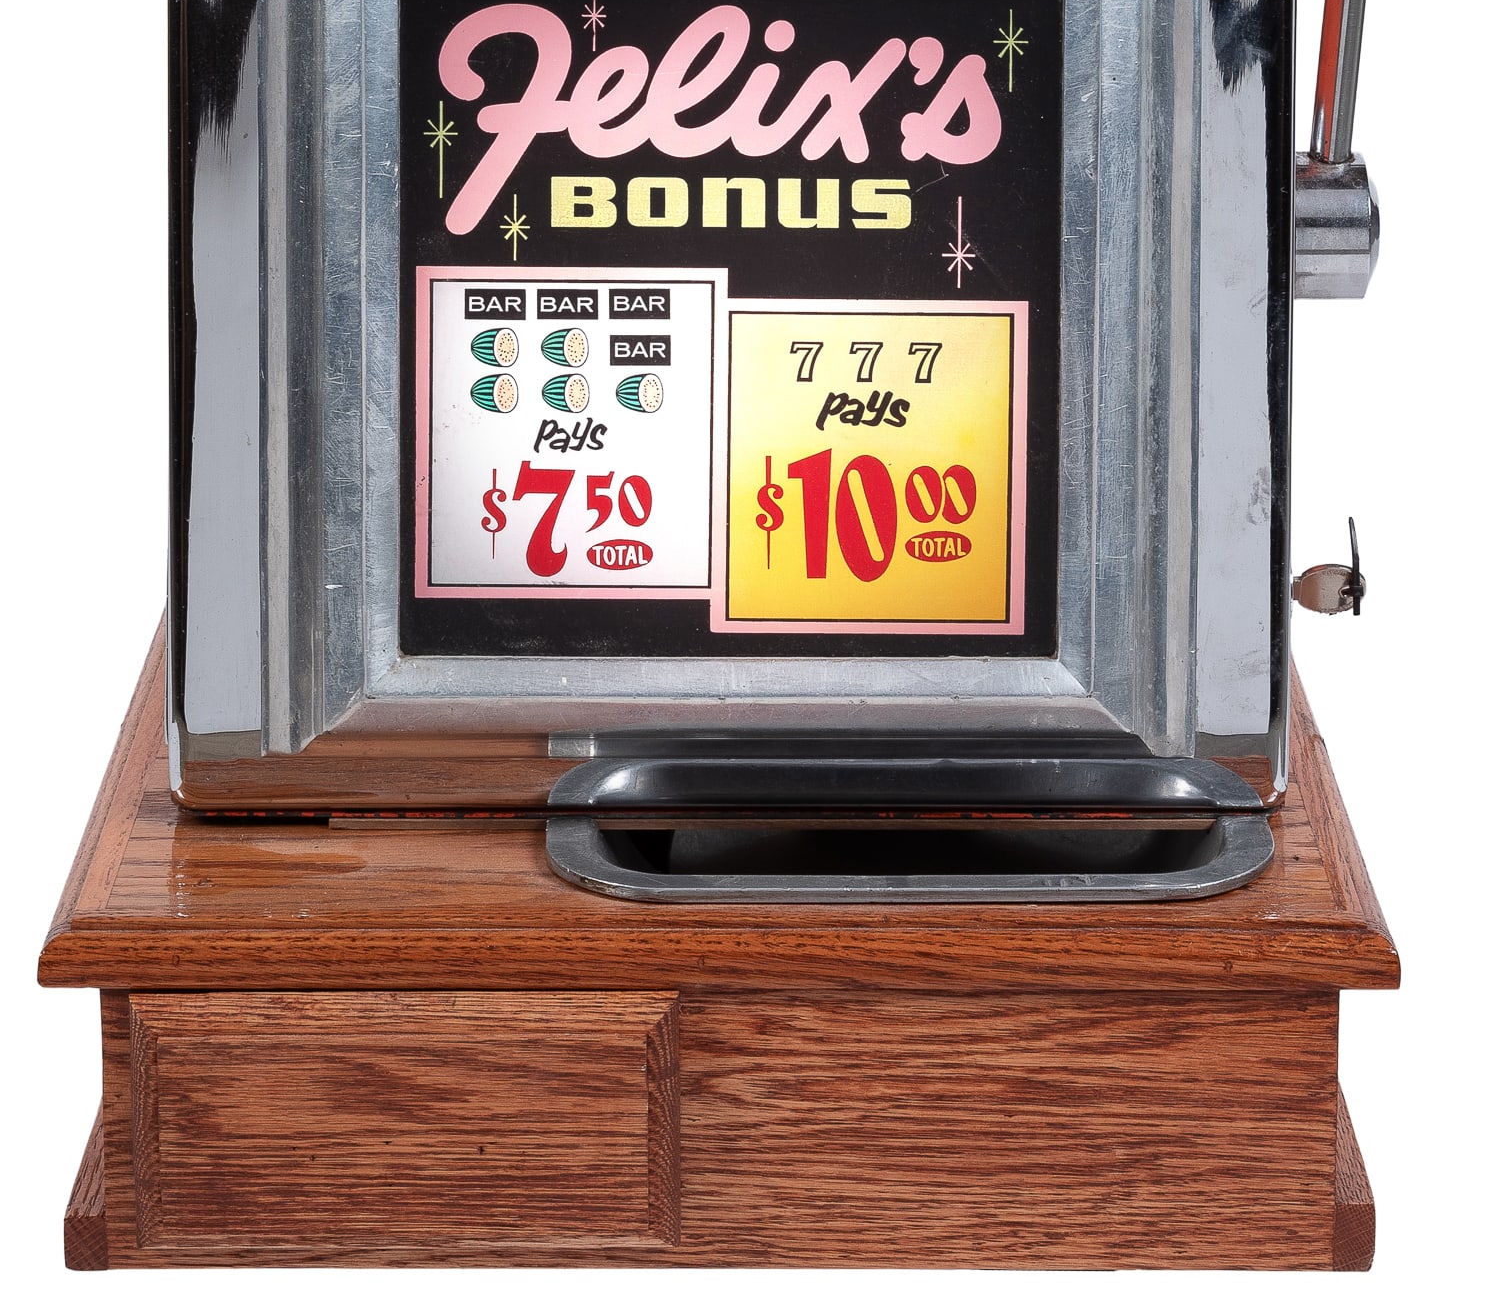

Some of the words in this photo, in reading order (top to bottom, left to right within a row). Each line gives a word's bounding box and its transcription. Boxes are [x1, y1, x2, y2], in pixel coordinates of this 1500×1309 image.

[438, 3, 1002, 235] Felix's
[468, 296, 522, 313] BAR
[539, 296, 594, 313] BAR
[613, 295, 665, 312] BAR
[614, 342, 666, 358] BAR
[591, 544, 649, 566] TOTAL
[910, 537, 967, 557] TOTAL
